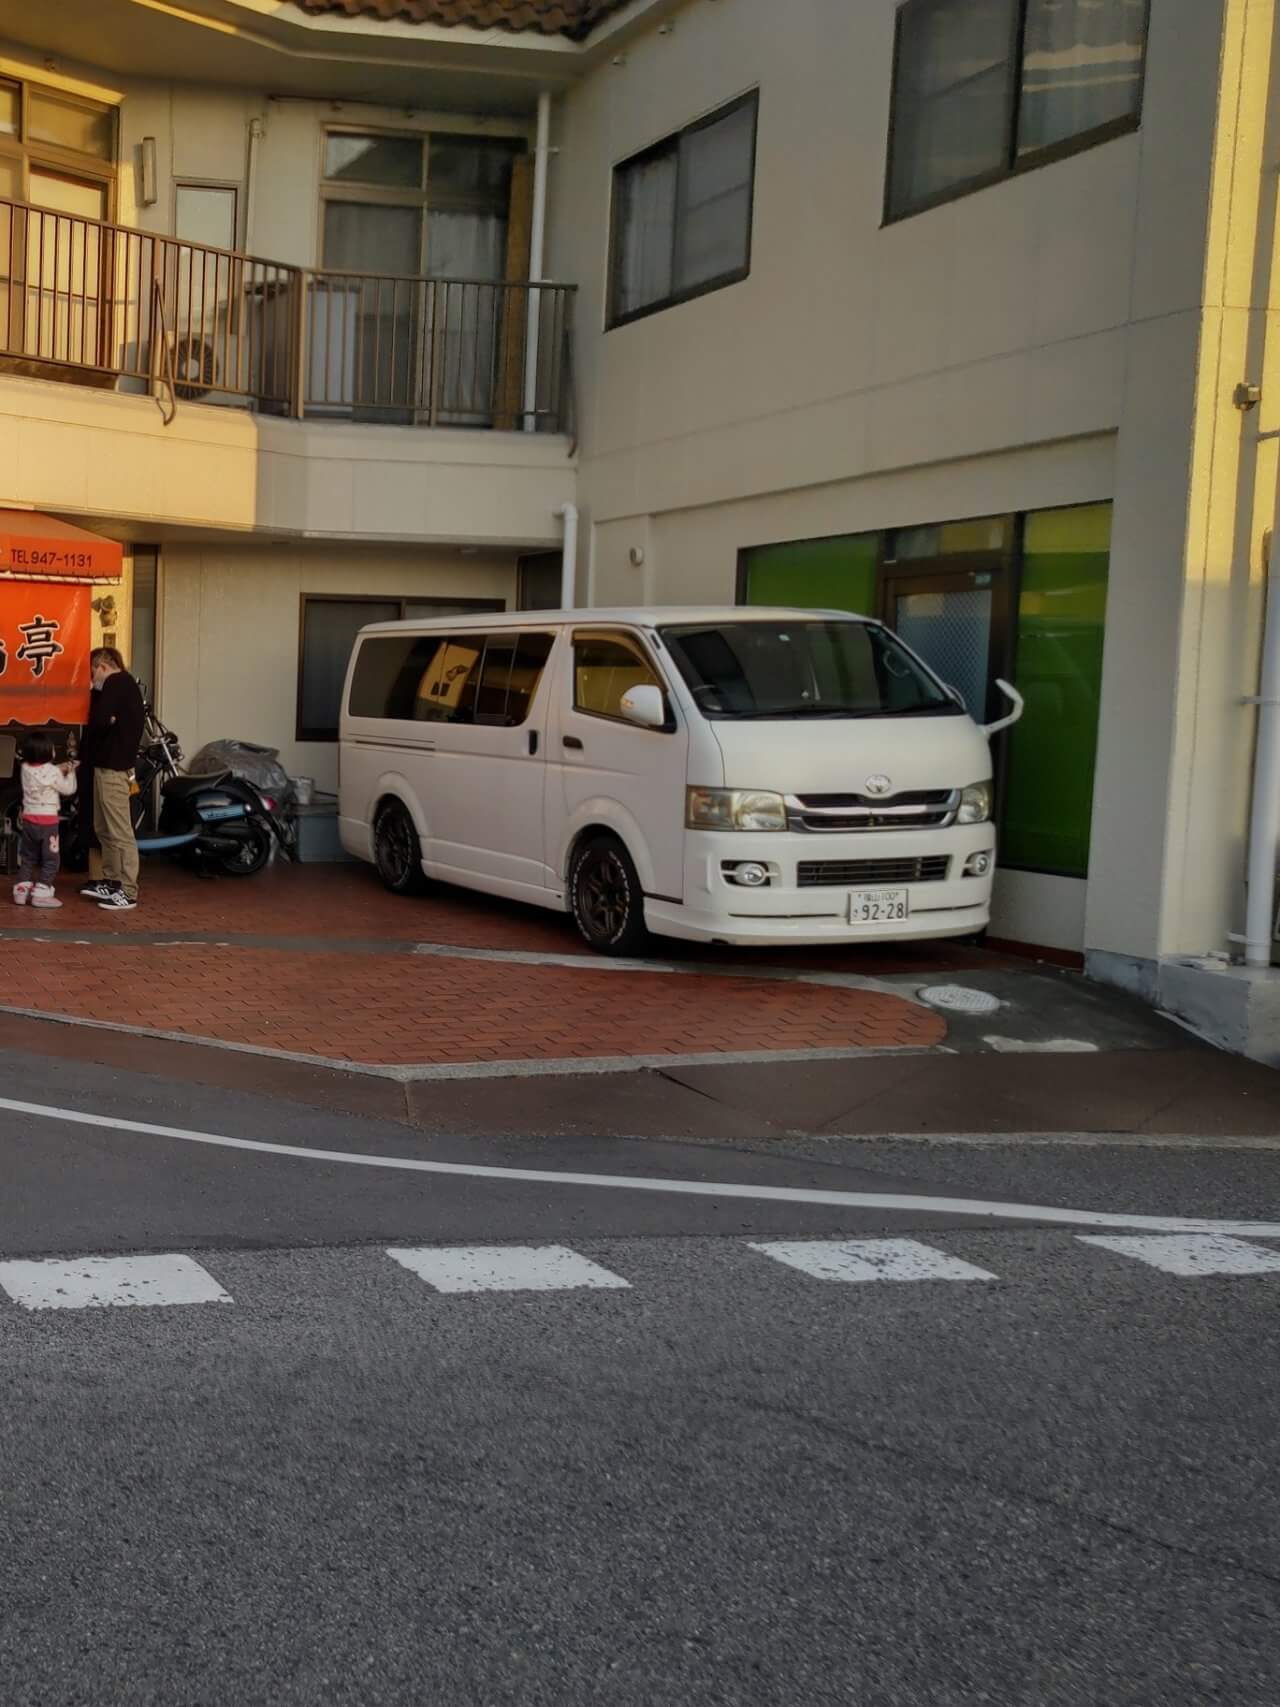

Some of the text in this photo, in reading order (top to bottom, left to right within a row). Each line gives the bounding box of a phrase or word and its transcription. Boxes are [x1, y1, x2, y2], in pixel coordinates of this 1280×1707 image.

[11, 549, 28, 564] TEL
[30, 550, 93, 568] 947-1131
[862, 902, 904, 921] 92-28
